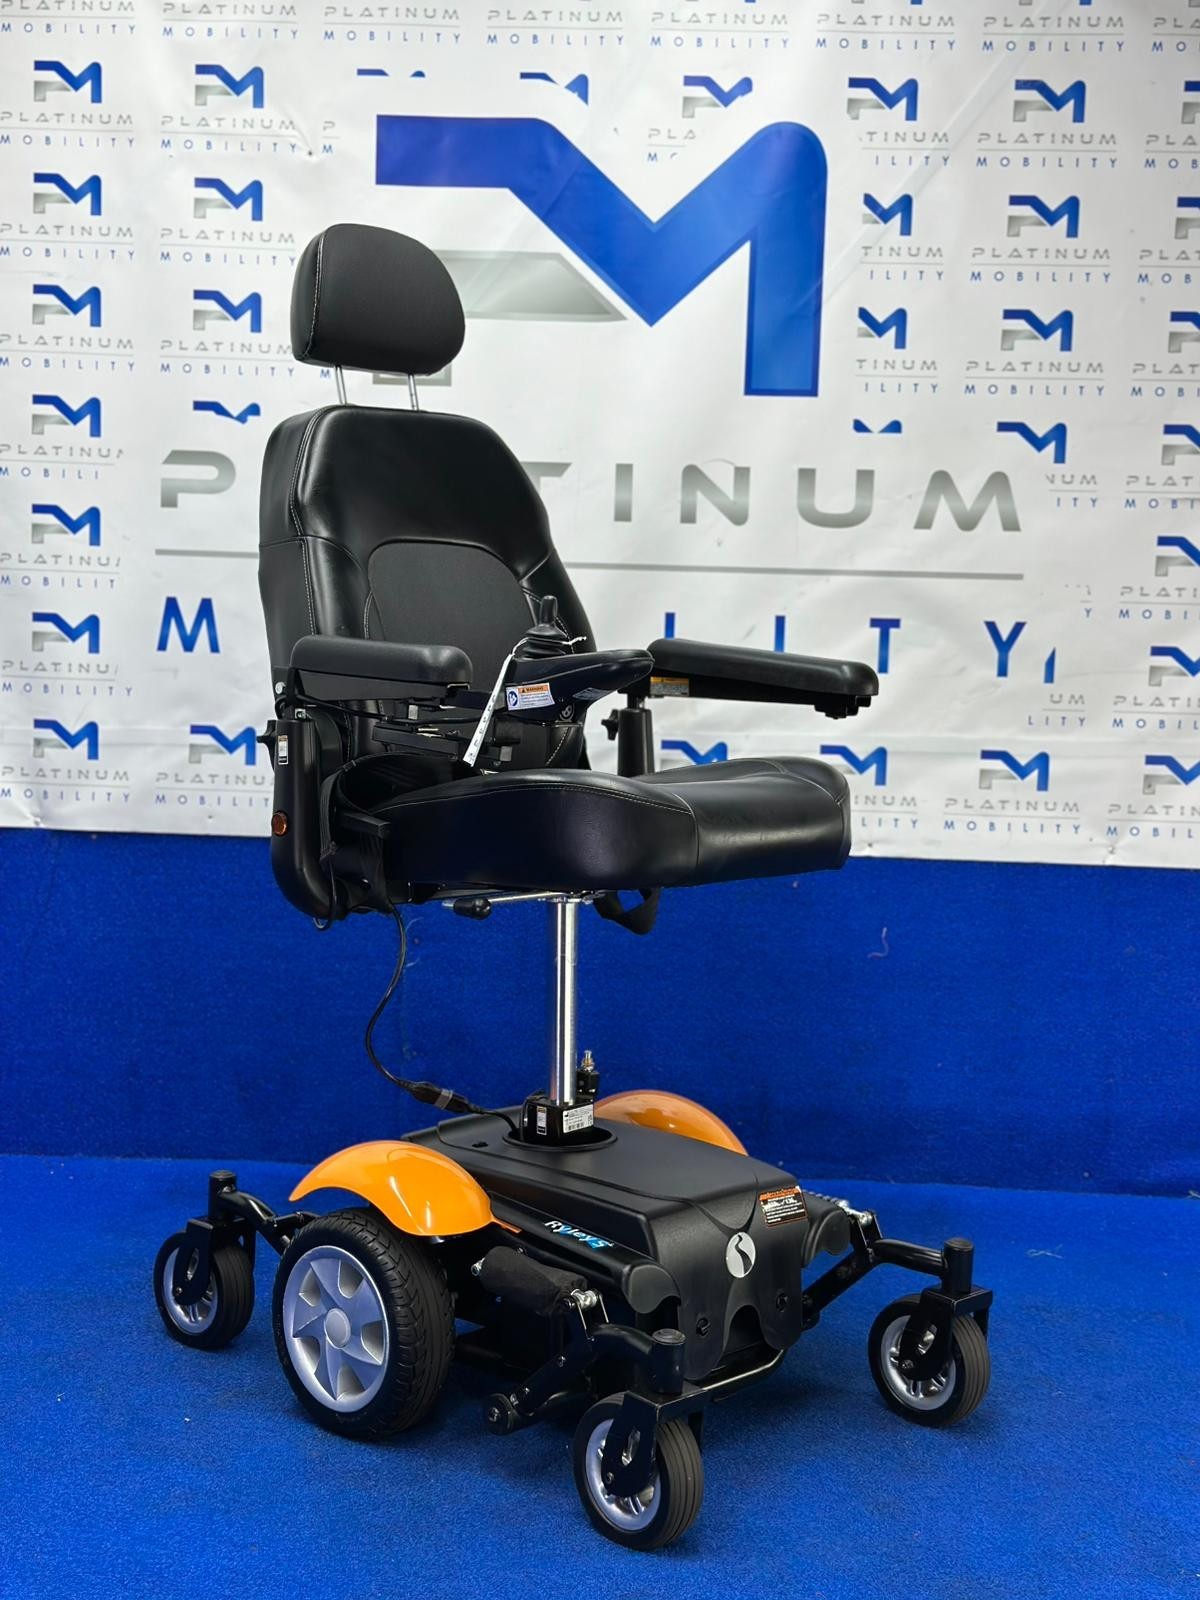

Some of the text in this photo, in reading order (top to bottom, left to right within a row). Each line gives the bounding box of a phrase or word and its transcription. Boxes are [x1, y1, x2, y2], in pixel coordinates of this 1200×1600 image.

[1, 0, 134, 11] PLATINUM
[162, 2, 296, 16] PLATINUM
[324, 6, 459, 20] PLATINUM
[488, 9, 622, 22] PLATINUM
[651, 12, 788, 25] PLATINUM
[817, 14, 954, 27] PLATINUM
[983, 16, 1124, 28] PLATINUM
[1, 22, 135, 34] MOBILITY
[162, 26, 298, 39] MOBILITY
[323, 30, 460, 42] MOBILITY
[487, 33, 624, 46] MOBILITY
[650, 36, 789, 48] MOBILITY
[816, 38, 955, 51] MOBILITY
[981, 40, 1124, 52] MOBILITY
[0, 111, 133, 125] PLATINUM
[161, 115, 296, 130] PLATINUM
[0, 134, 134, 147] MOBILITY
[977, 132, 1116, 145] PLATINUM
[161, 139, 296, 152] MOBILITY
[976, 156, 1117, 168] MOBILITY
[0, 223, 133, 237] PLATINUM
[161, 228, 294, 243] PLATINUM
[0, 246, 134, 260] MOBILITY
[160, 251, 296, 266] MOBILITY
[972, 247, 1110, 260] PLATINUM
[970, 271, 1111, 283] MOBILITY
[0, 333, 133, 349] PLATINUM
[160, 340, 292, 354] PLATINUM
[0, 356, 134, 372] MOBILITY
[160, 363, 294, 377] MOBILITY
[966, 361, 1104, 373] PLATINUM
[964, 384, 1104, 396] MOBILITY
[0, 552, 121, 567] PLATINU
[2, 660, 119, 675] PLATINU
[2, 682, 132, 696] MOBILITY
[2, 766, 129, 781] PLATINUM
[156, 772, 274, 786] PLATINU
[0, 788, 130, 802] MOBILITY
[945, 798, 1079, 812] PLATINUM
[943, 820, 1080, 834] MOBILITY
